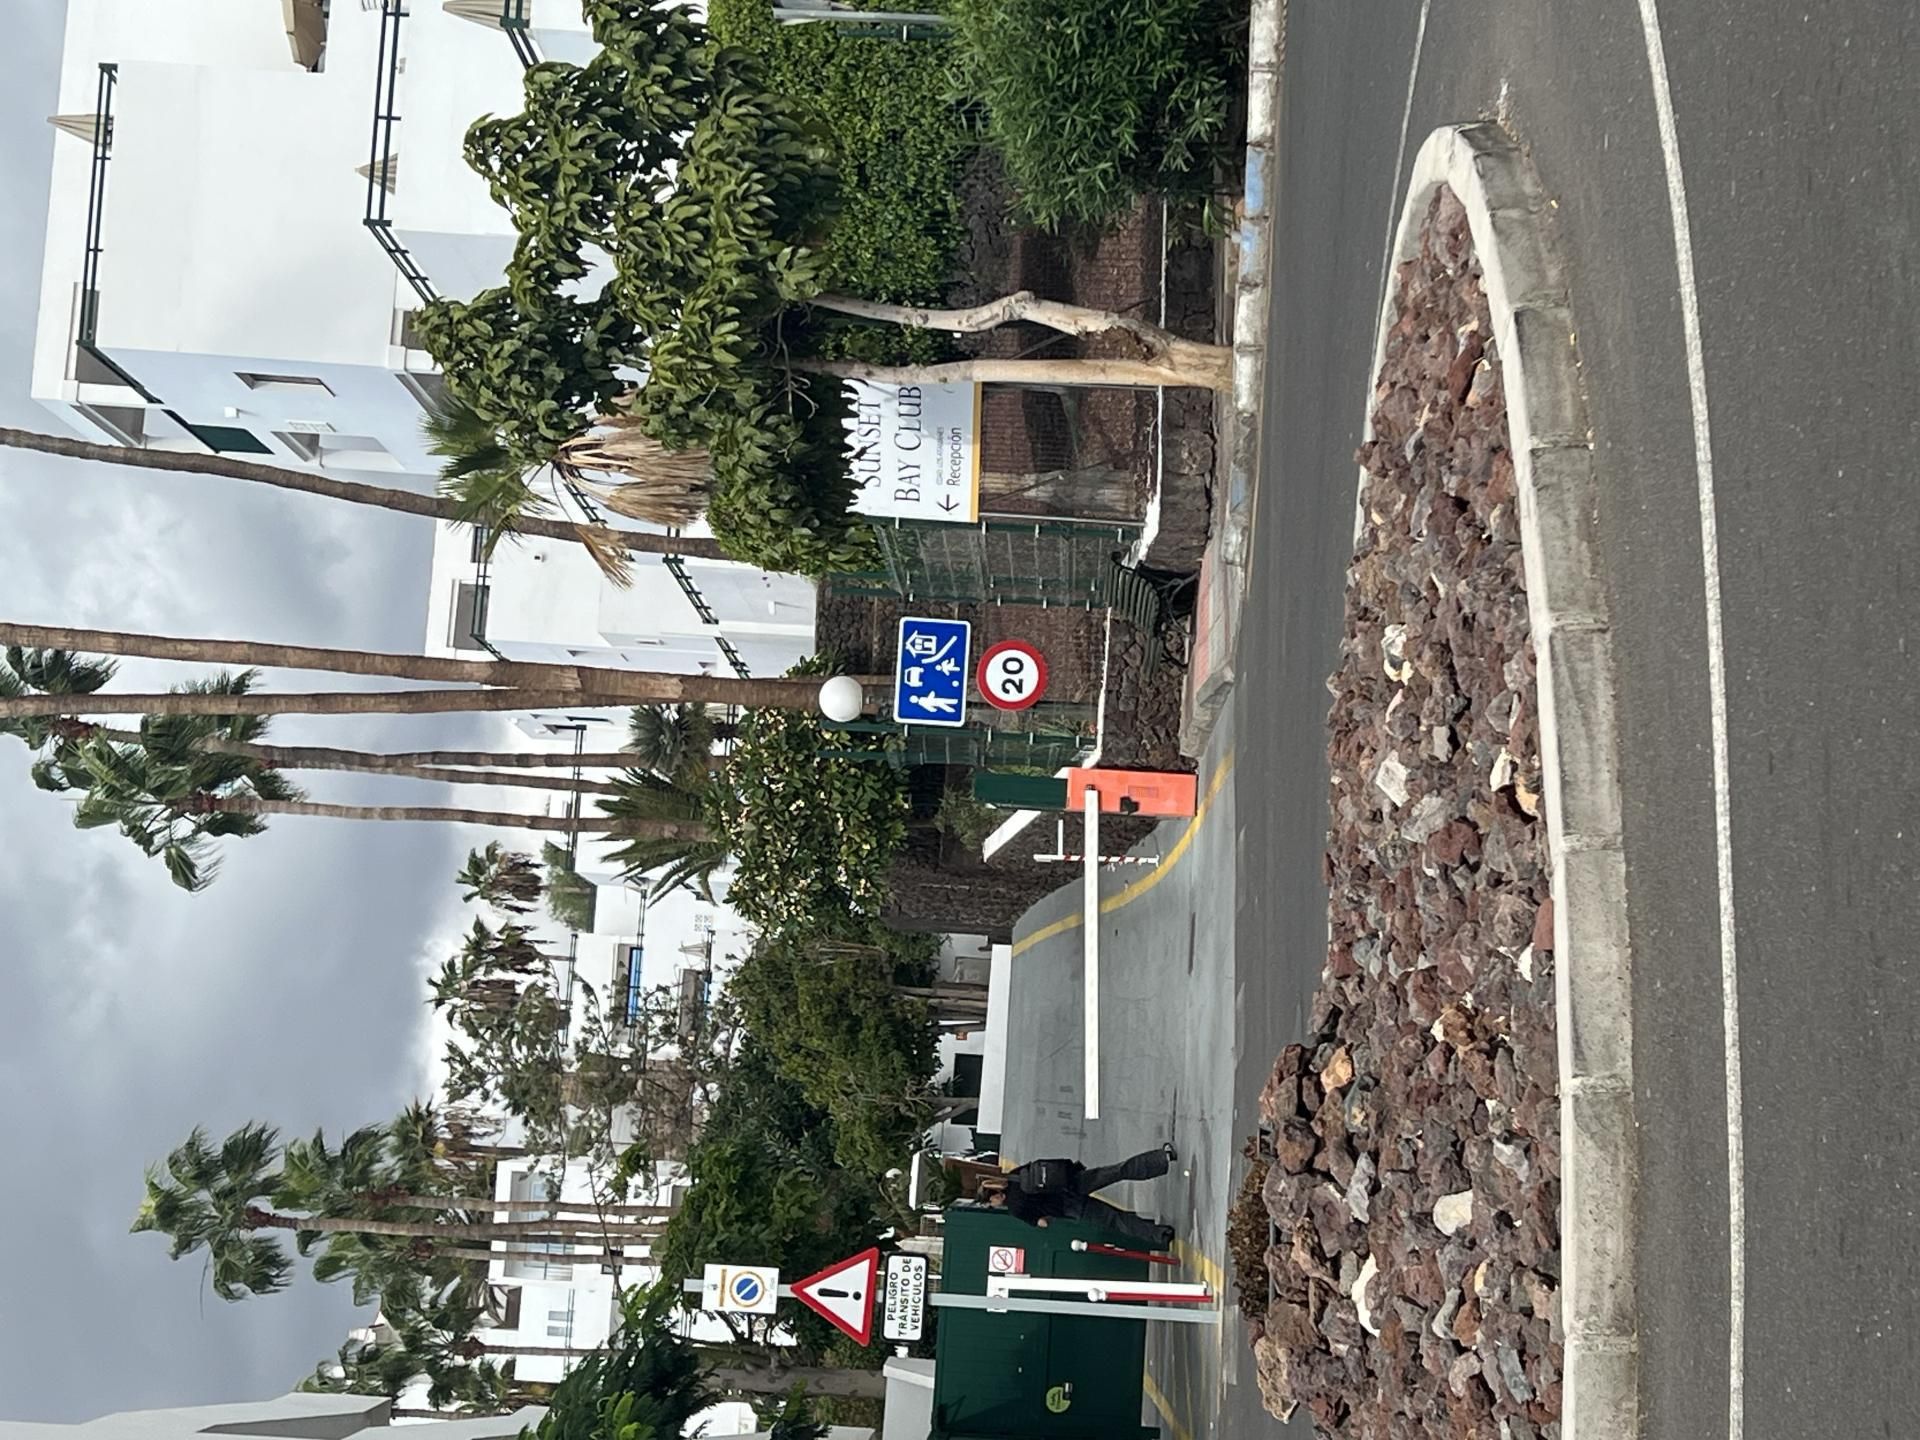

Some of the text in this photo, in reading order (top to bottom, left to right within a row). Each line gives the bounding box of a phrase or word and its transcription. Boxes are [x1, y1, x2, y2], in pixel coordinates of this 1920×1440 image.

[894, 386, 922, 503] BAY CLUB
[945, 427, 965, 486] Recepción
[1001, 657, 1024, 695] 20
[902, 1258, 912, 1272] DE
[887, 1272, 899, 1321] PELIGRO
